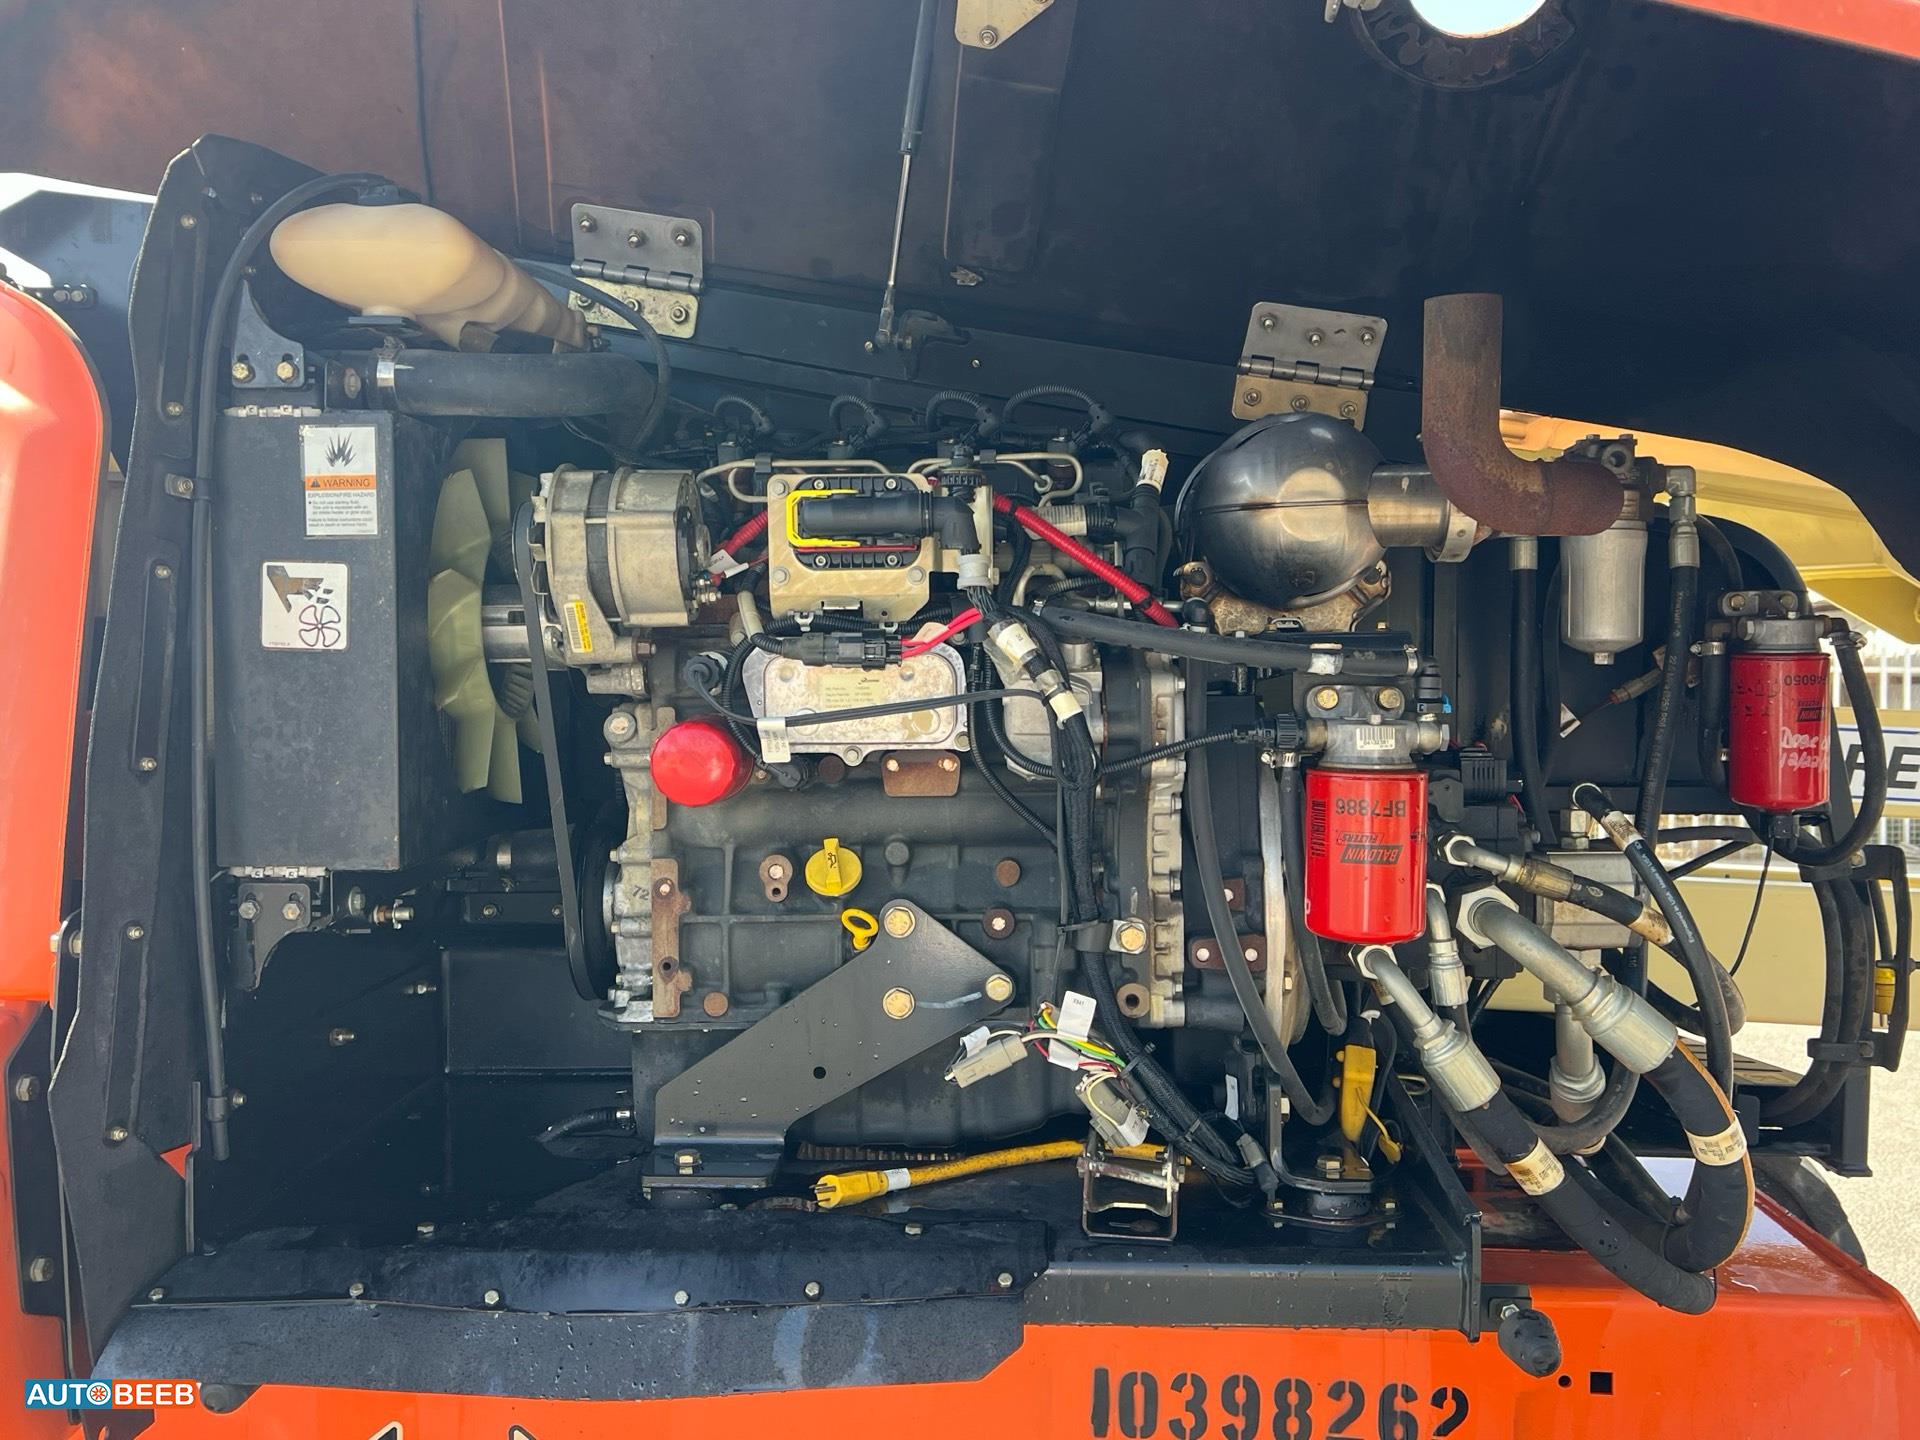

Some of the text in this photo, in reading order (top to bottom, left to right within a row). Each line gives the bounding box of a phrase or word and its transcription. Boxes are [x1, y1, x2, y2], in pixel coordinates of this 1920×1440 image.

[323, 478, 370, 488] WARNING
[1335, 799, 1406, 817] BF7886
[1342, 833, 1378, 844] FILTERS
[1344, 848, 1398, 861] BALDWIN
[632, 884, 650, 901] 72
[1091, 1367, 1470, 1440] 10398262
